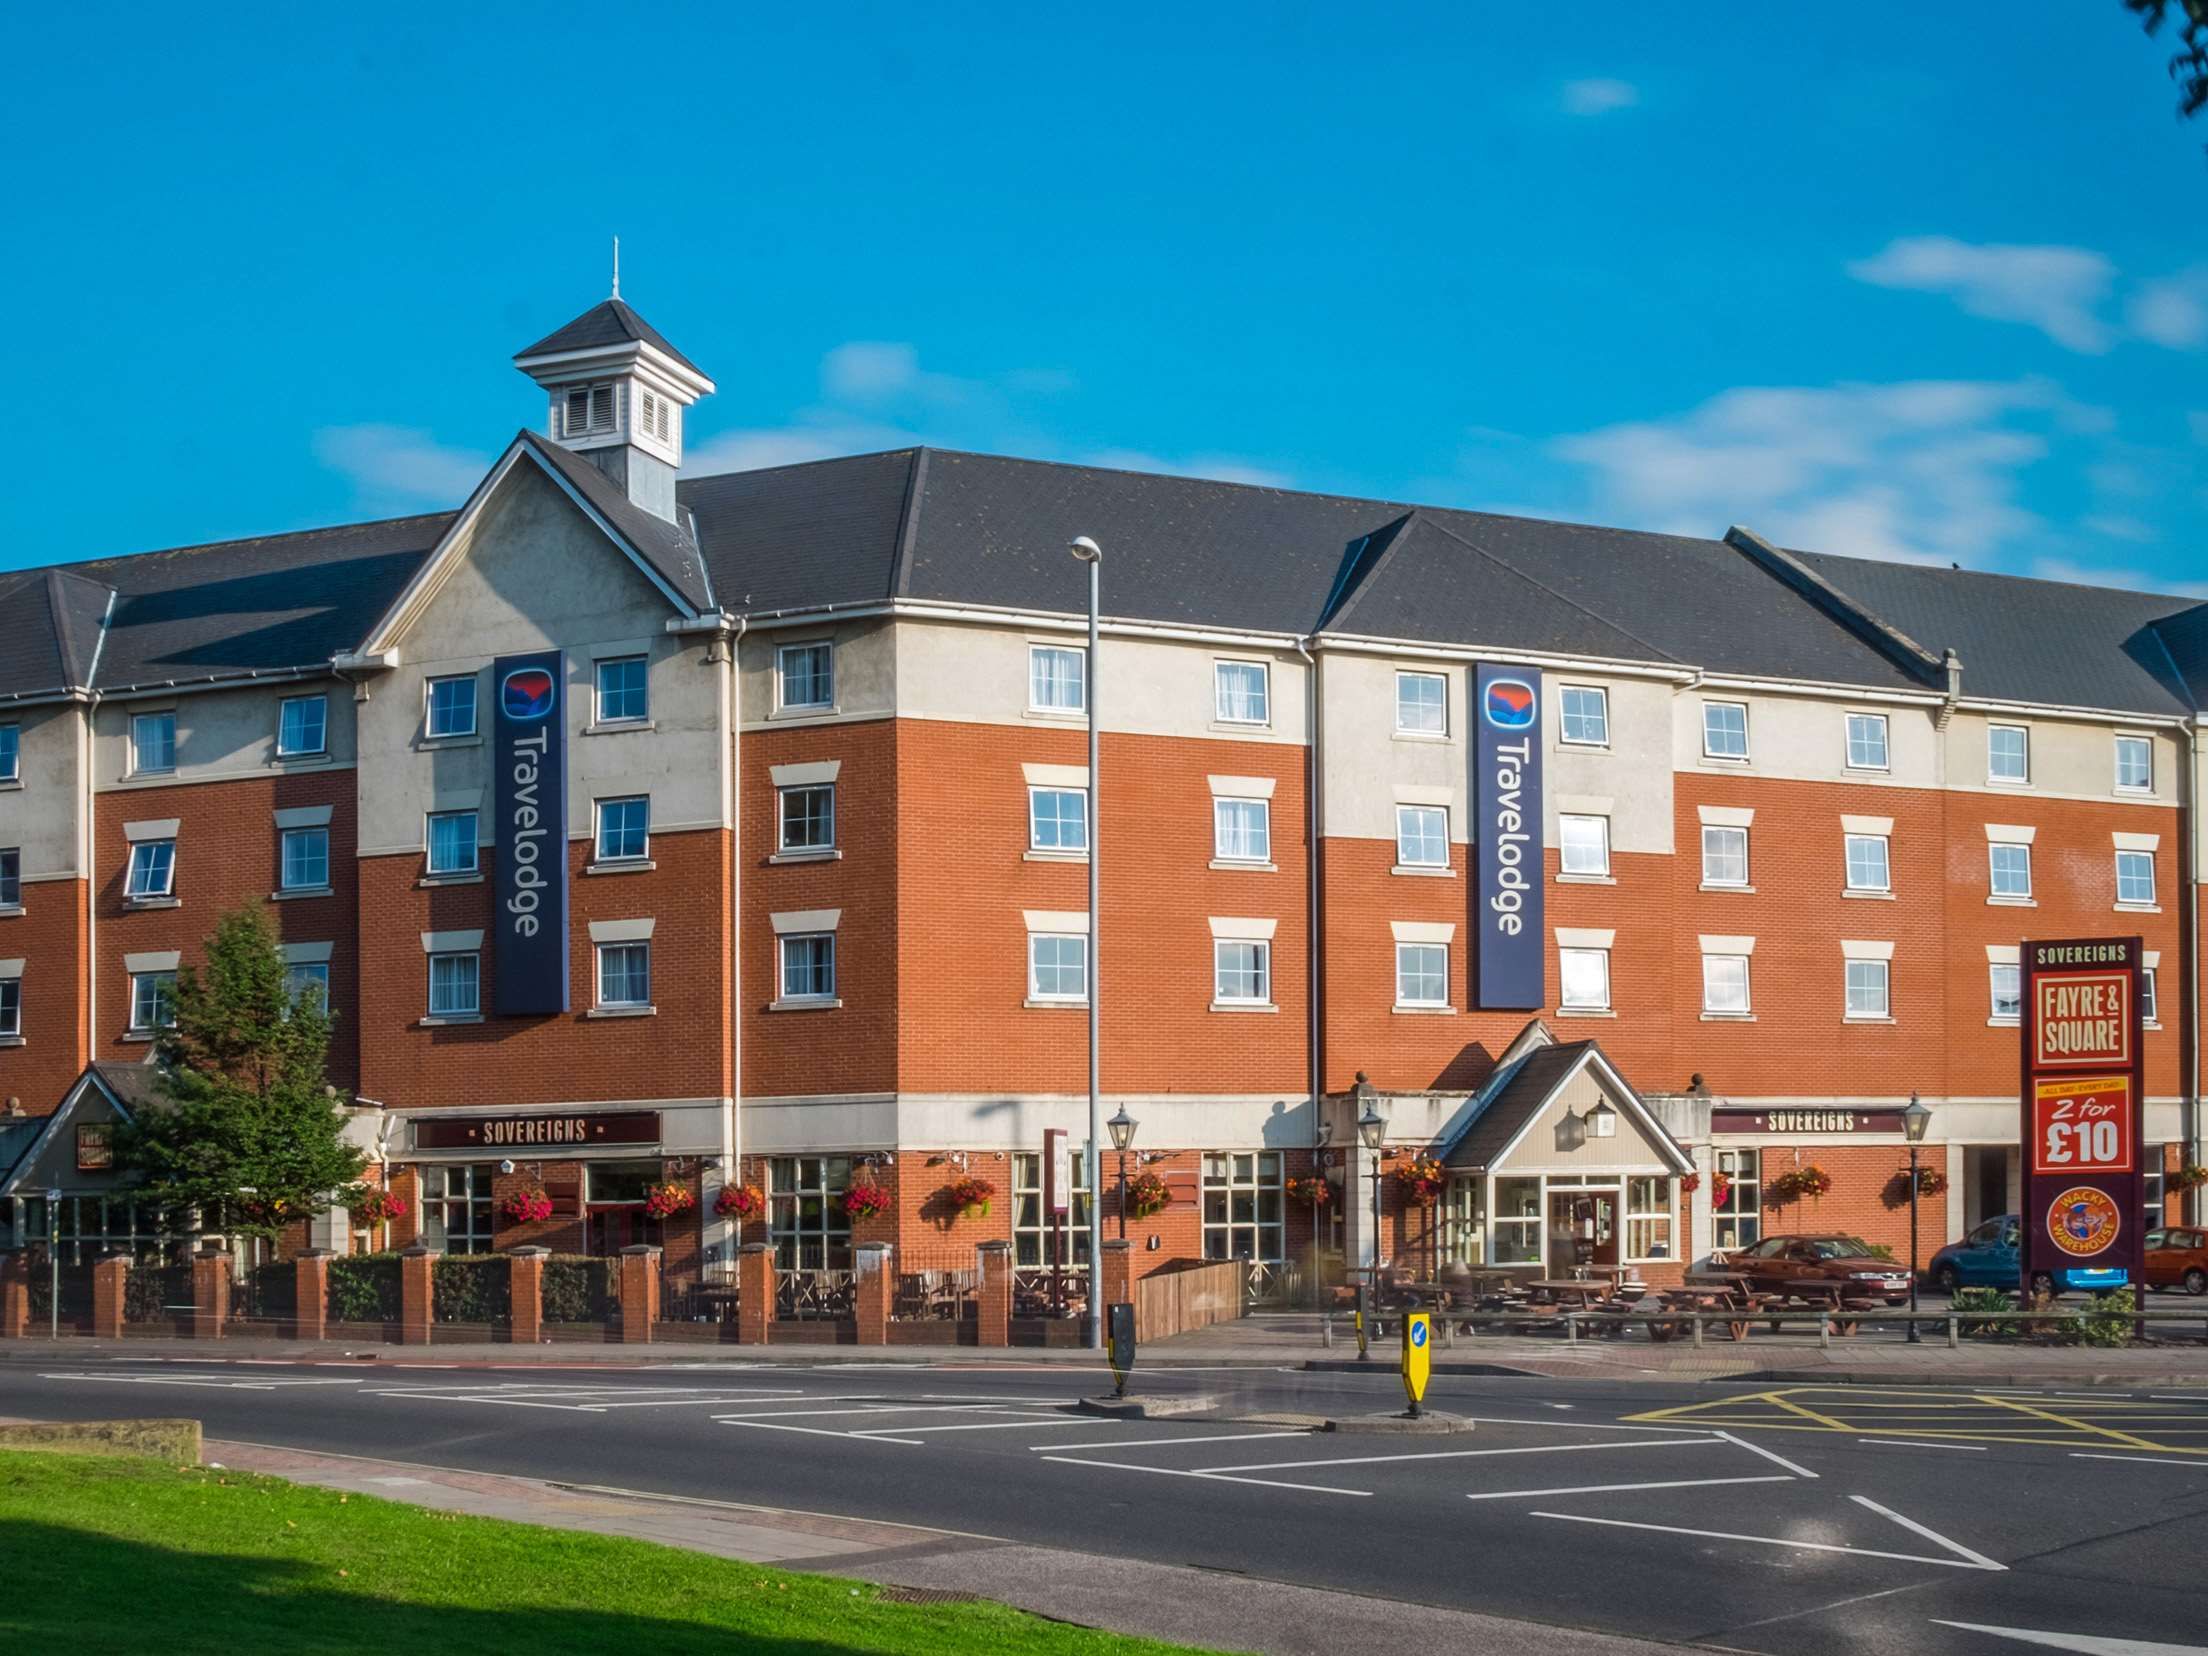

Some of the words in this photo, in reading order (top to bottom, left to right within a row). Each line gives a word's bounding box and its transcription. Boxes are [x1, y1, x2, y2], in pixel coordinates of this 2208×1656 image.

[507, 726, 548, 937] Travelodge
[1490, 737, 1531, 936] Travelodge
[2037, 944, 2126, 965] SOVEREIGNS
[2045, 985, 2104, 1018] FAYRE
[2107, 985, 2119, 1016] &
[2045, 1020, 2119, 1055] SQUARE
[1768, 1111, 1854, 1131] SOVEREIGNS
[2051, 1099, 2074, 1120] 2
[2079, 1097, 2116, 1119] for
[484, 1119, 586, 1144] SOVEREIGNS
[2046, 1120, 2118, 1163] £10
[2060, 1191, 2107, 1208] WACKY
[2053, 1222, 2115, 1251] WAREHOUSE
